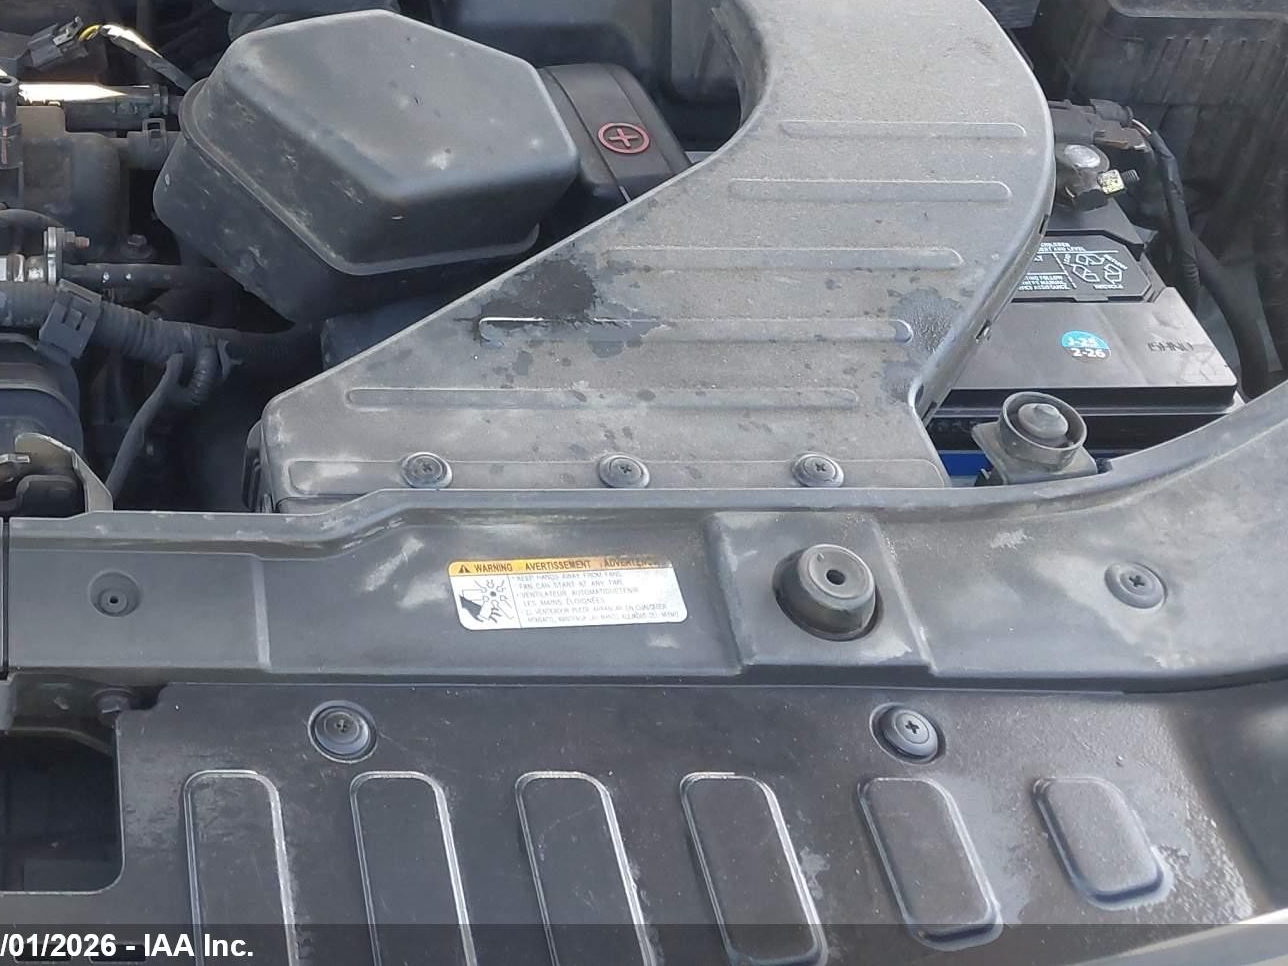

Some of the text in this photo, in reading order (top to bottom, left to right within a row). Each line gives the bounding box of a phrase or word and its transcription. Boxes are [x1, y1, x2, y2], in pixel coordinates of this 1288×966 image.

[1071, 347, 1106, 358] 2-26
[474, 563, 512, 573] WARNING
[525, 560, 591, 571] AVERTISSEMENT
